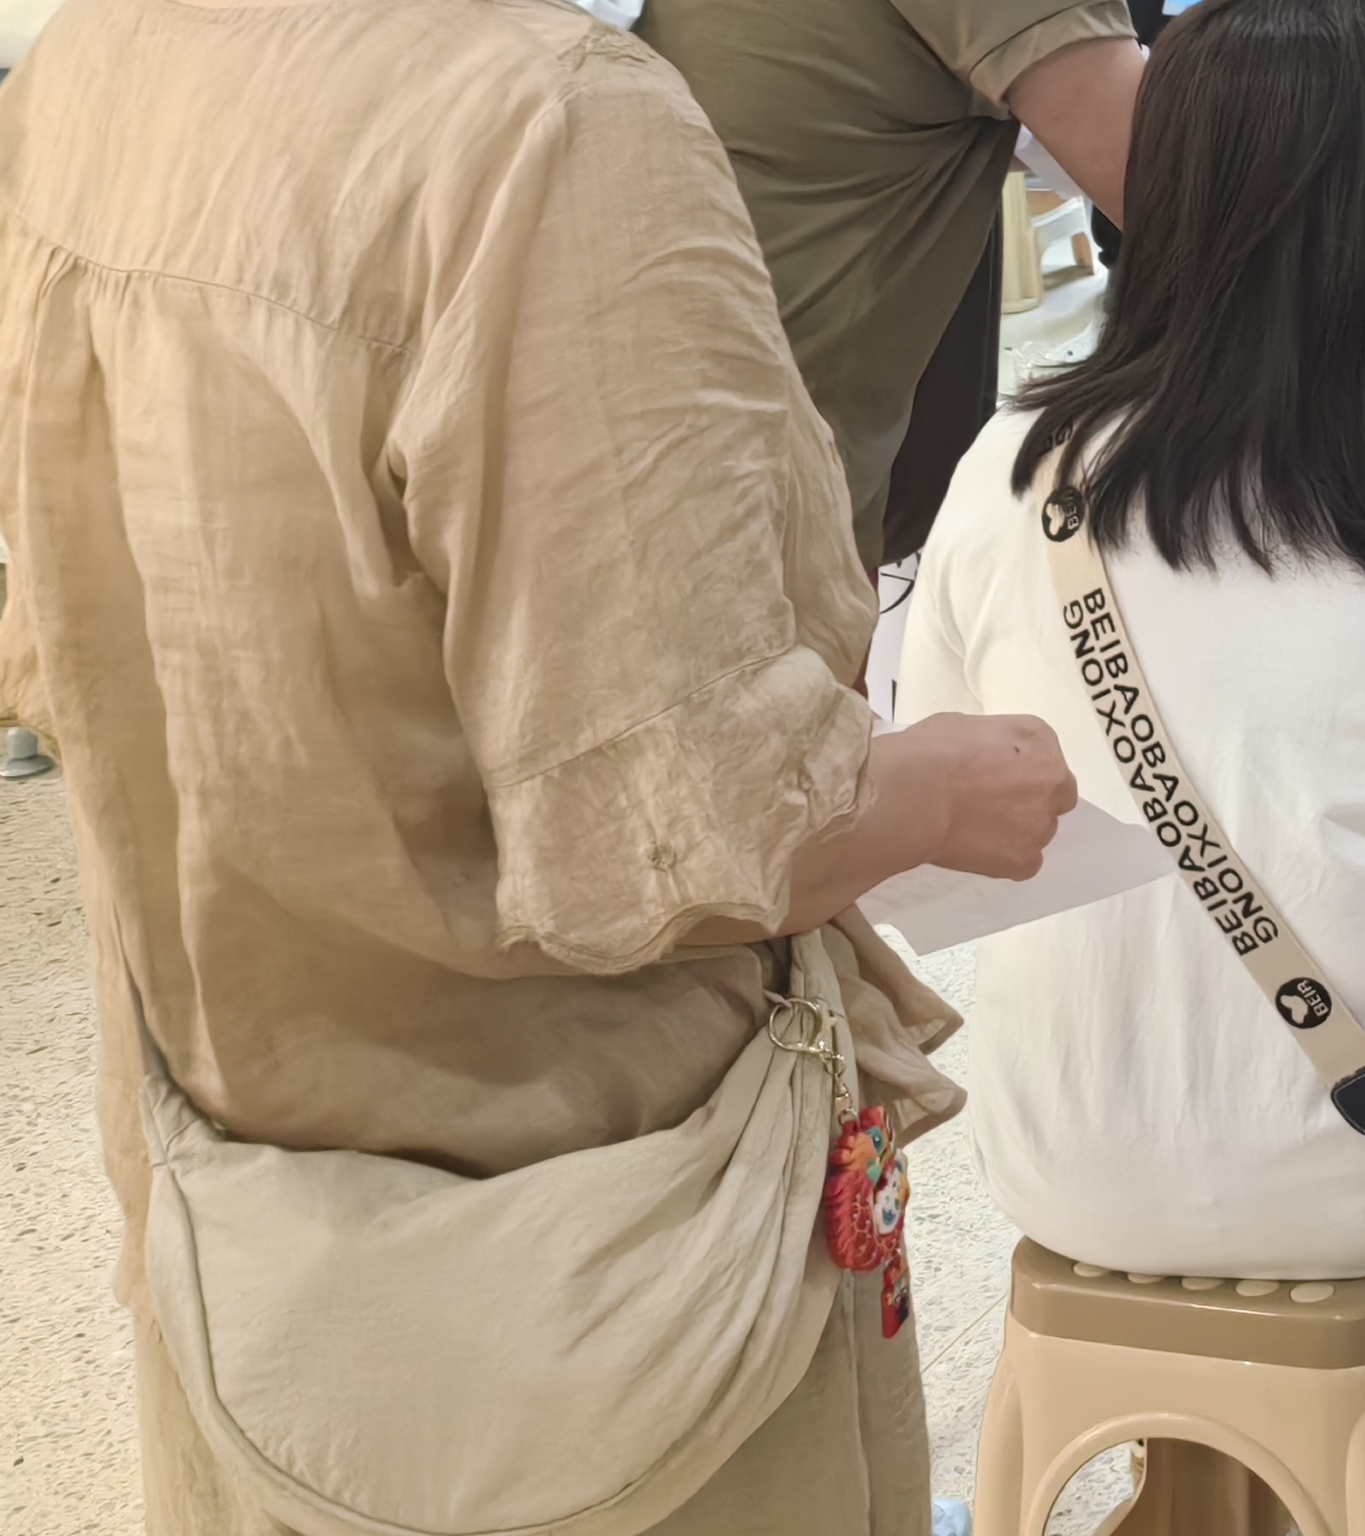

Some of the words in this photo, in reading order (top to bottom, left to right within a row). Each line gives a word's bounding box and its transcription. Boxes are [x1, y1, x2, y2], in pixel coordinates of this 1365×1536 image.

[1063, 600, 1259, 956] BEIBAOBAOXIONG
[1083, 587, 1279, 944] BEIBAOBAOXIONG
[1297, 979, 1329, 1017] BEIR
